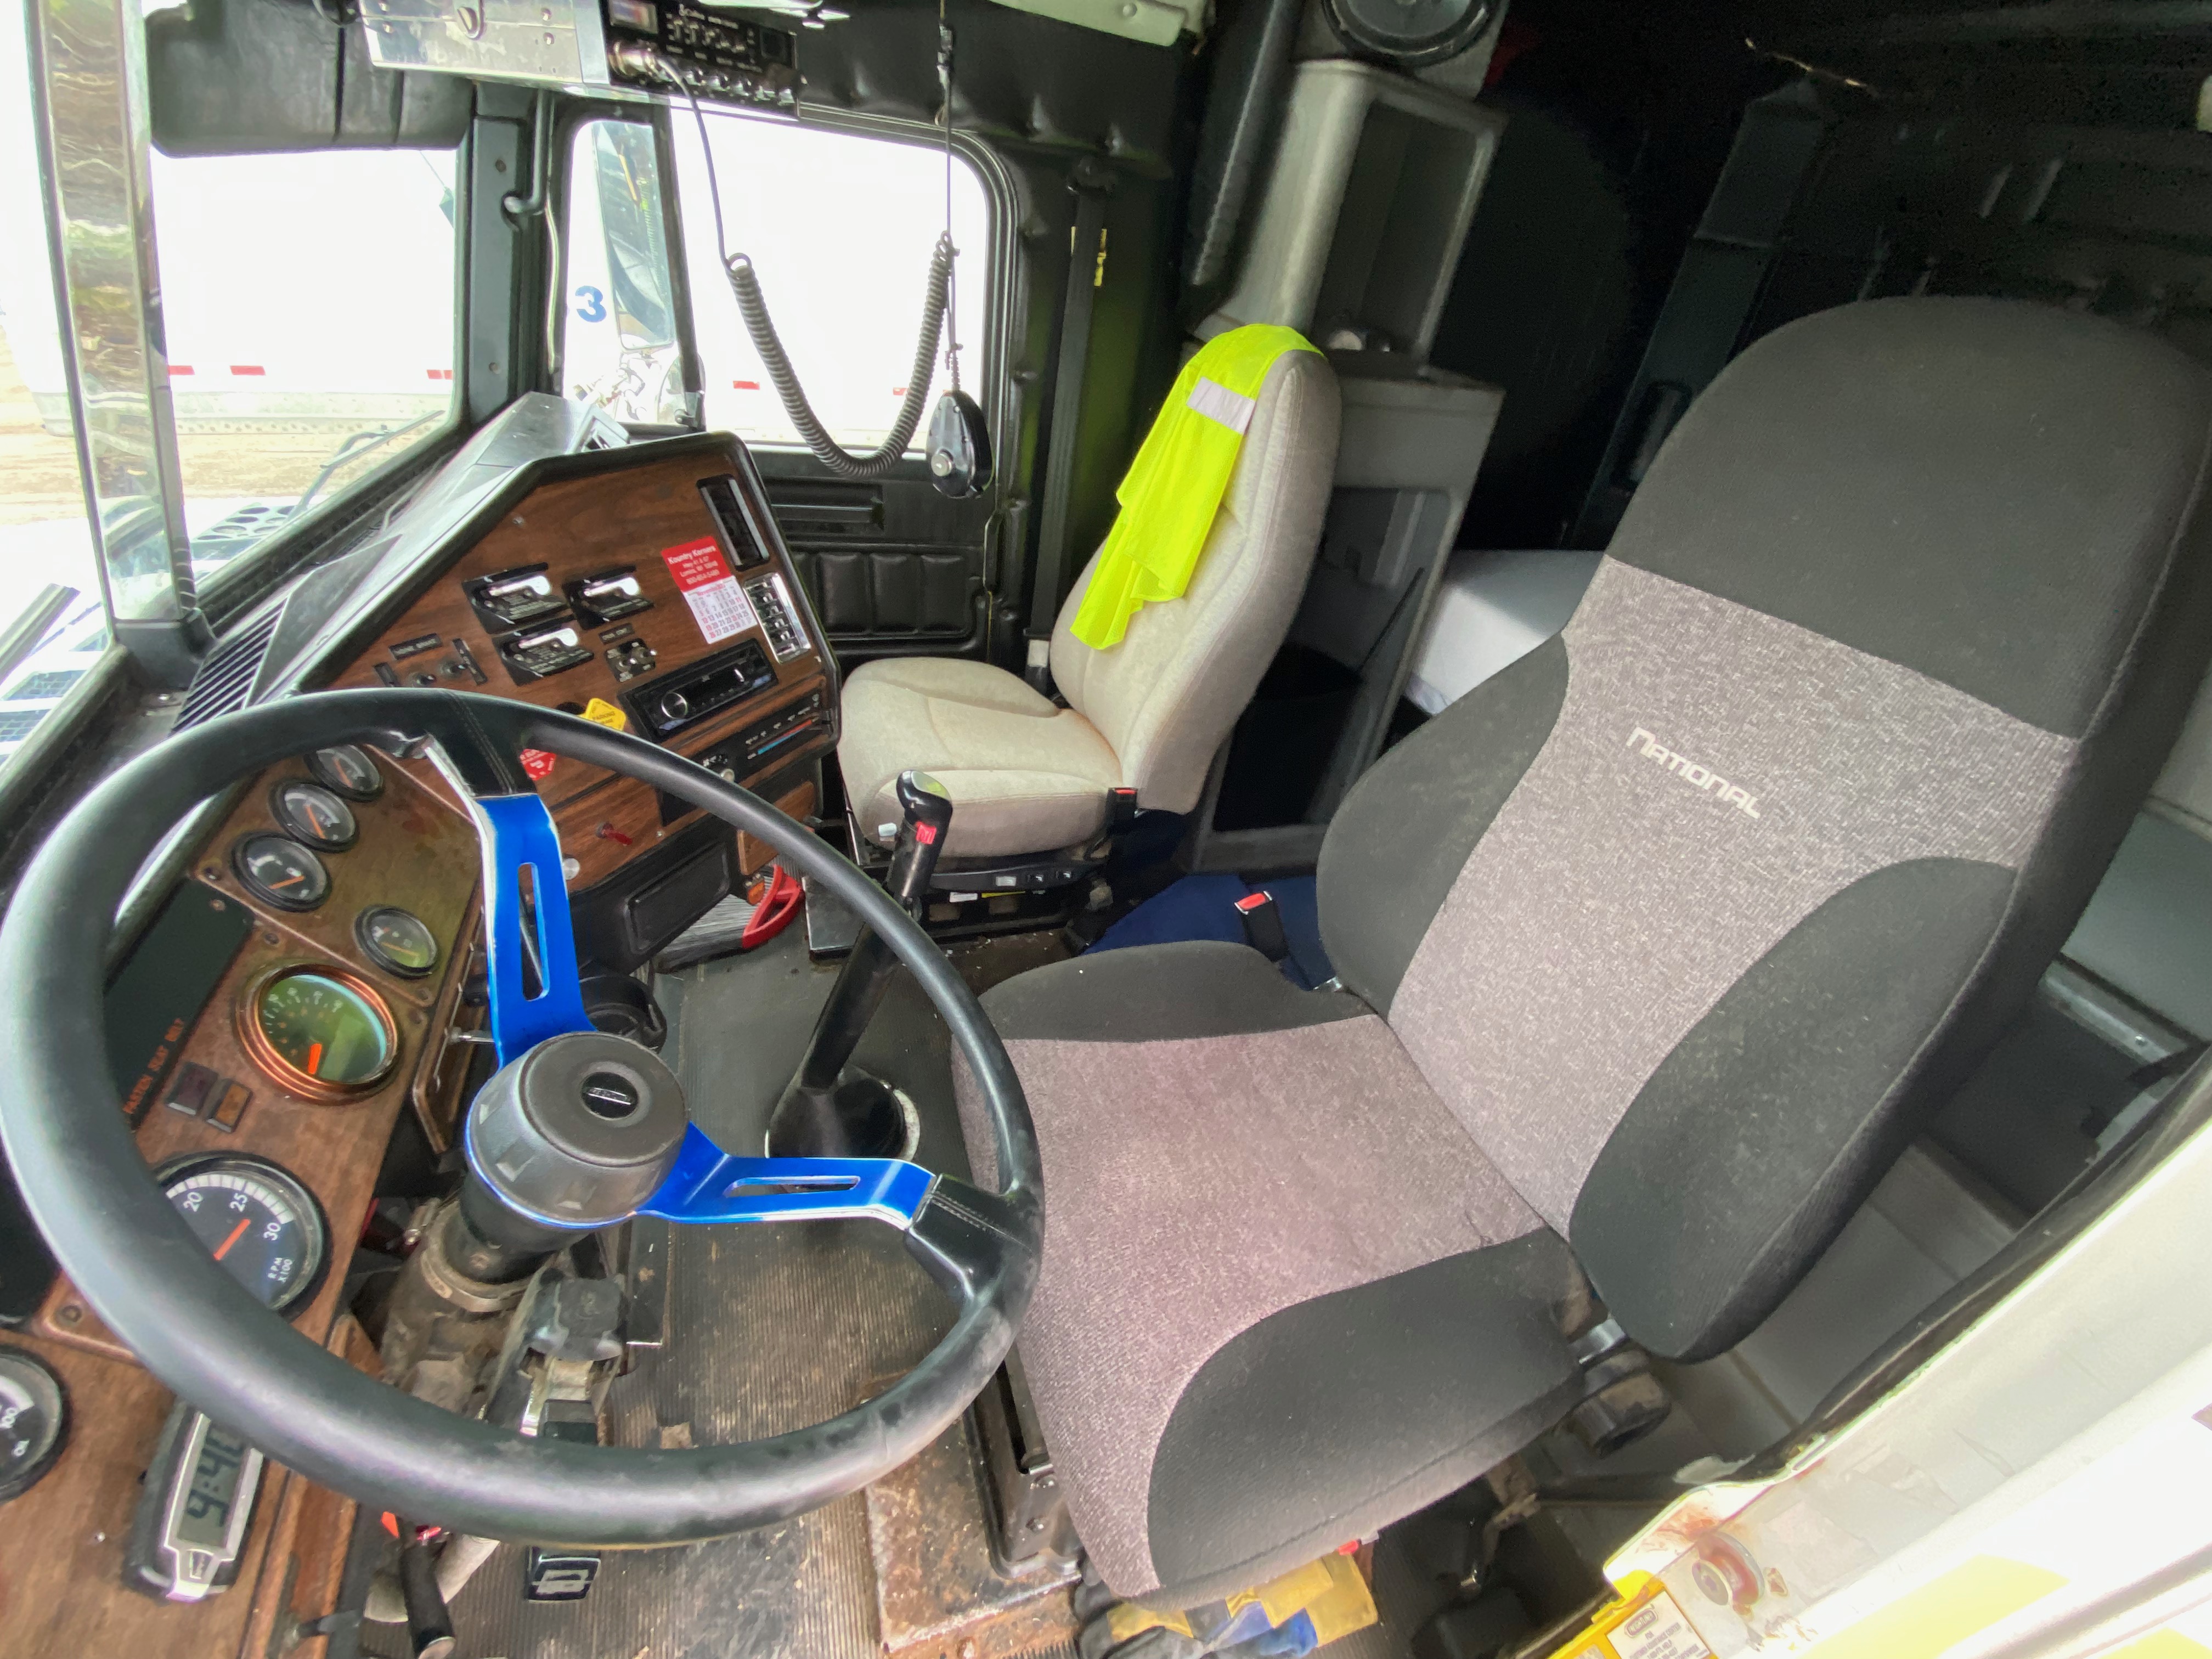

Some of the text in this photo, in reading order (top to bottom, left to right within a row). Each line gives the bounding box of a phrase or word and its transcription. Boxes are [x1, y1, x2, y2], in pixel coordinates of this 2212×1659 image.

[575, 285, 607, 323] 3
[183, 1192, 203, 1212] 20
[229, 1193, 248, 1212] 25
[263, 1222, 281, 1241] 30
[268, 1257, 283, 1279] RPM
